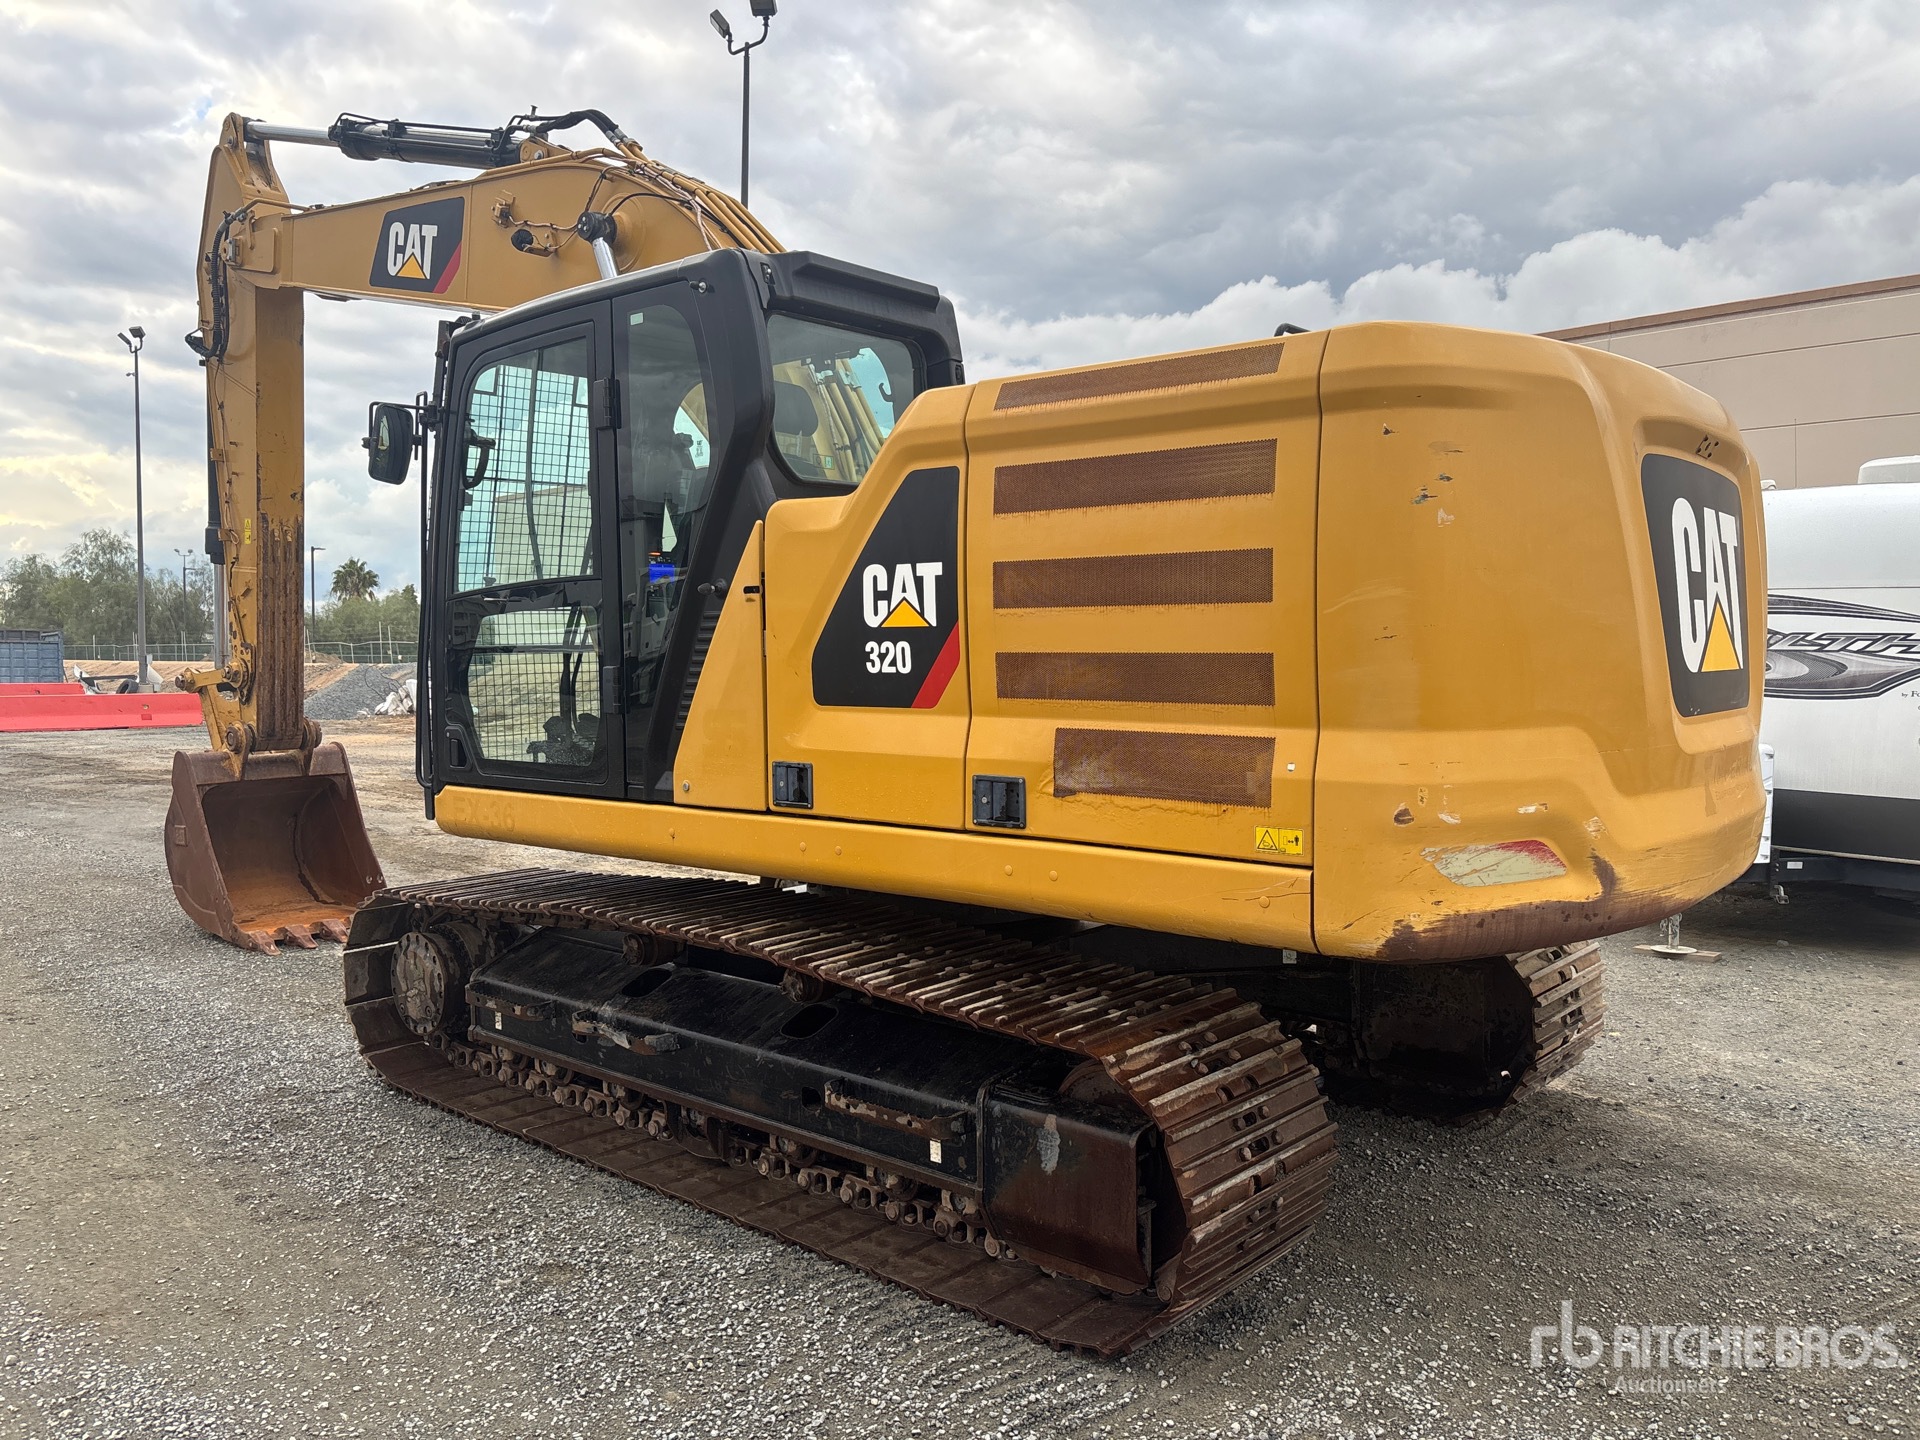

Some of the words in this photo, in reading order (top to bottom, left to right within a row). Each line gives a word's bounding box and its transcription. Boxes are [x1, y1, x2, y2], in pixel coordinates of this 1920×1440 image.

[387, 222, 438, 279] CAT
[863, 562, 943, 628] CAT
[1672, 497, 1744, 673] CAT
[865, 641, 912, 674] 320
